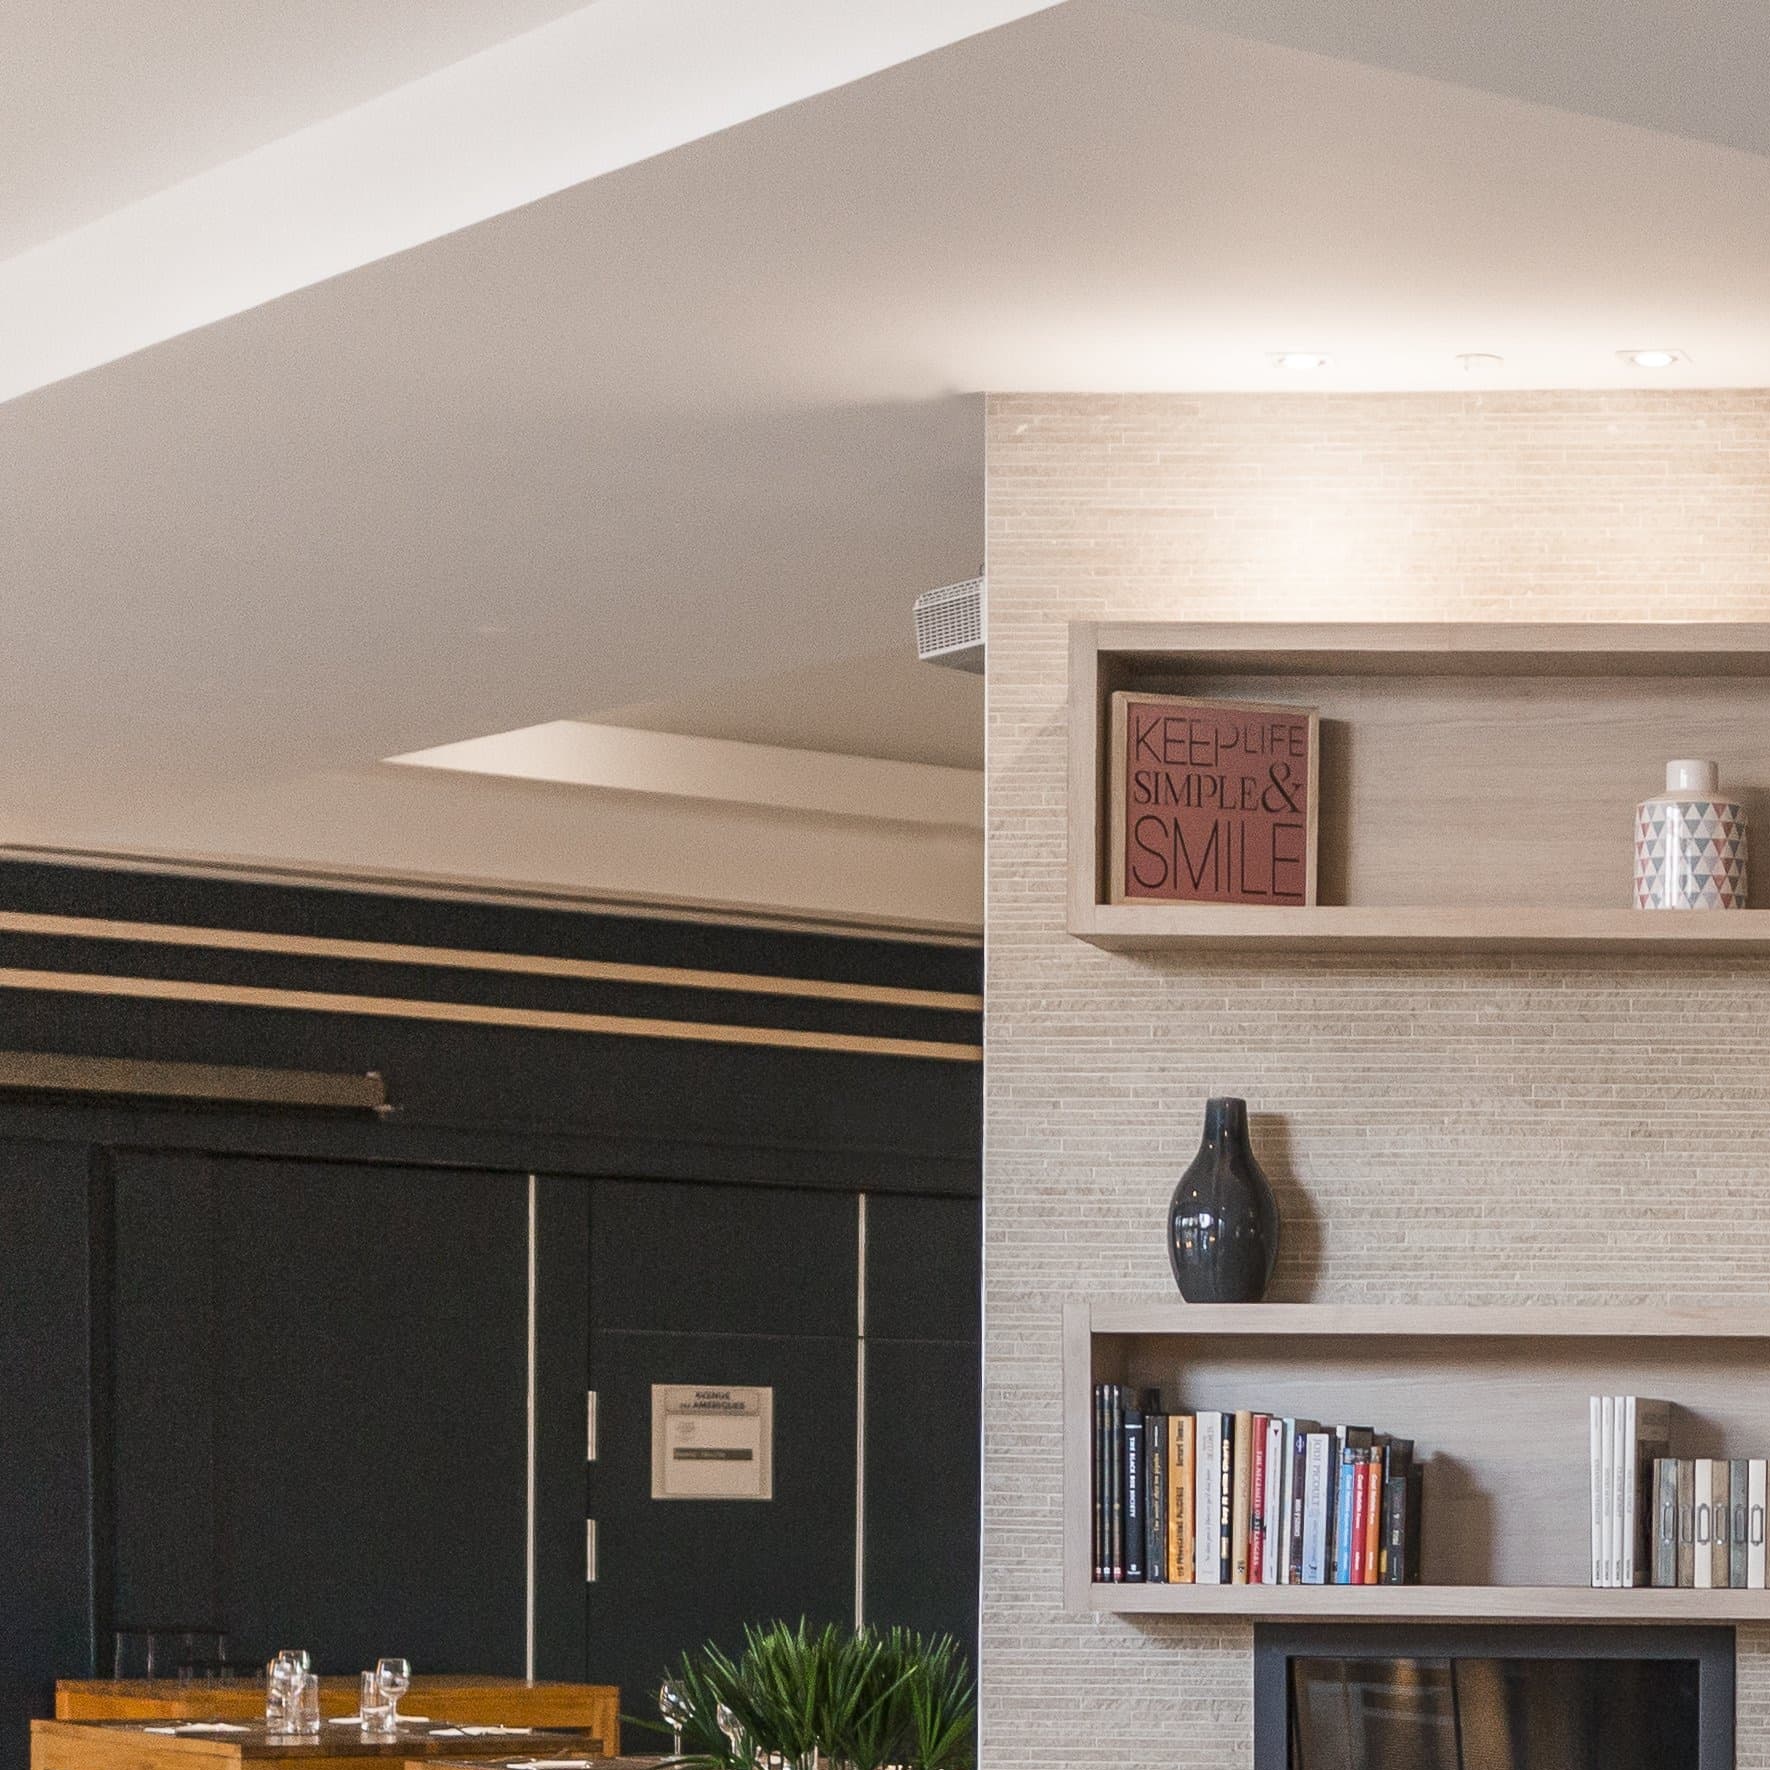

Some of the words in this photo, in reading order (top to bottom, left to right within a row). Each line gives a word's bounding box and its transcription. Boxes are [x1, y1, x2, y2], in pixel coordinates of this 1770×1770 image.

[1135, 715, 1240, 768] KEEP
[1243, 724, 1304, 757] LIFE
[1133, 769, 1260, 812] SIMPLE
[1260, 760, 1305, 814] &
[1132, 814, 1304, 898] SMILE
[1312, 1464, 1321, 1508] PICOULT
